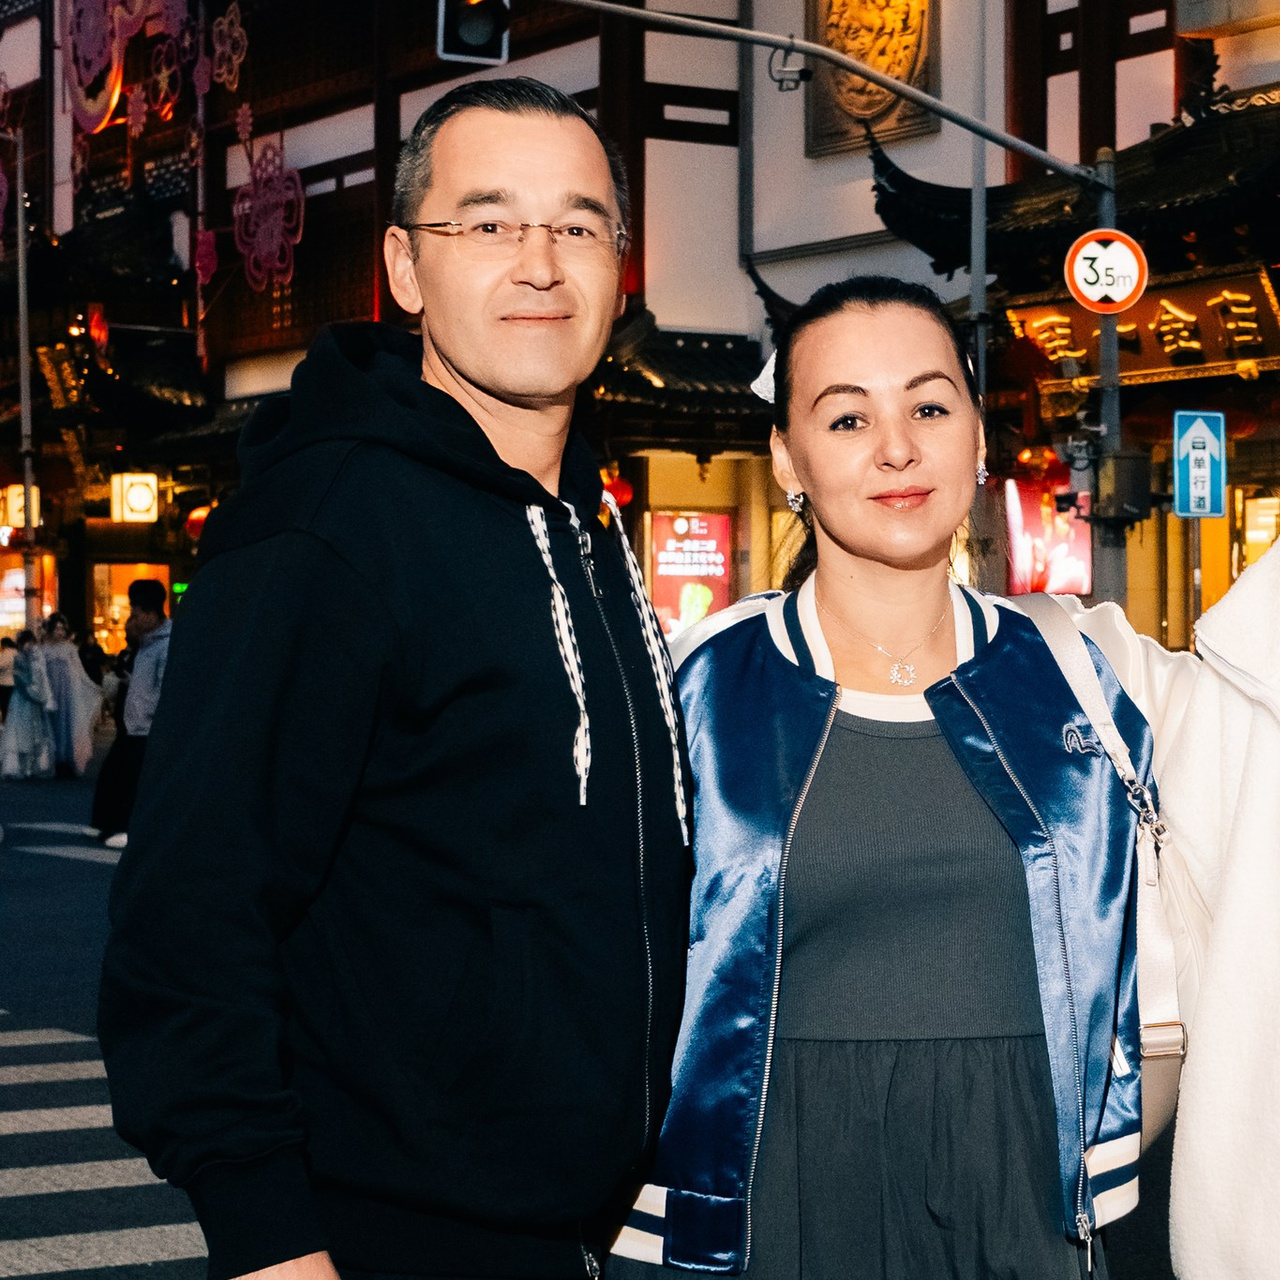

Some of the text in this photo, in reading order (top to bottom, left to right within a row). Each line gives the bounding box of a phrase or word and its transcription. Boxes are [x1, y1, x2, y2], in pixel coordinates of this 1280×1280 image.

[1082, 257, 1133, 287] 3.5m
[1193, 456, 1207, 509] 单行道
